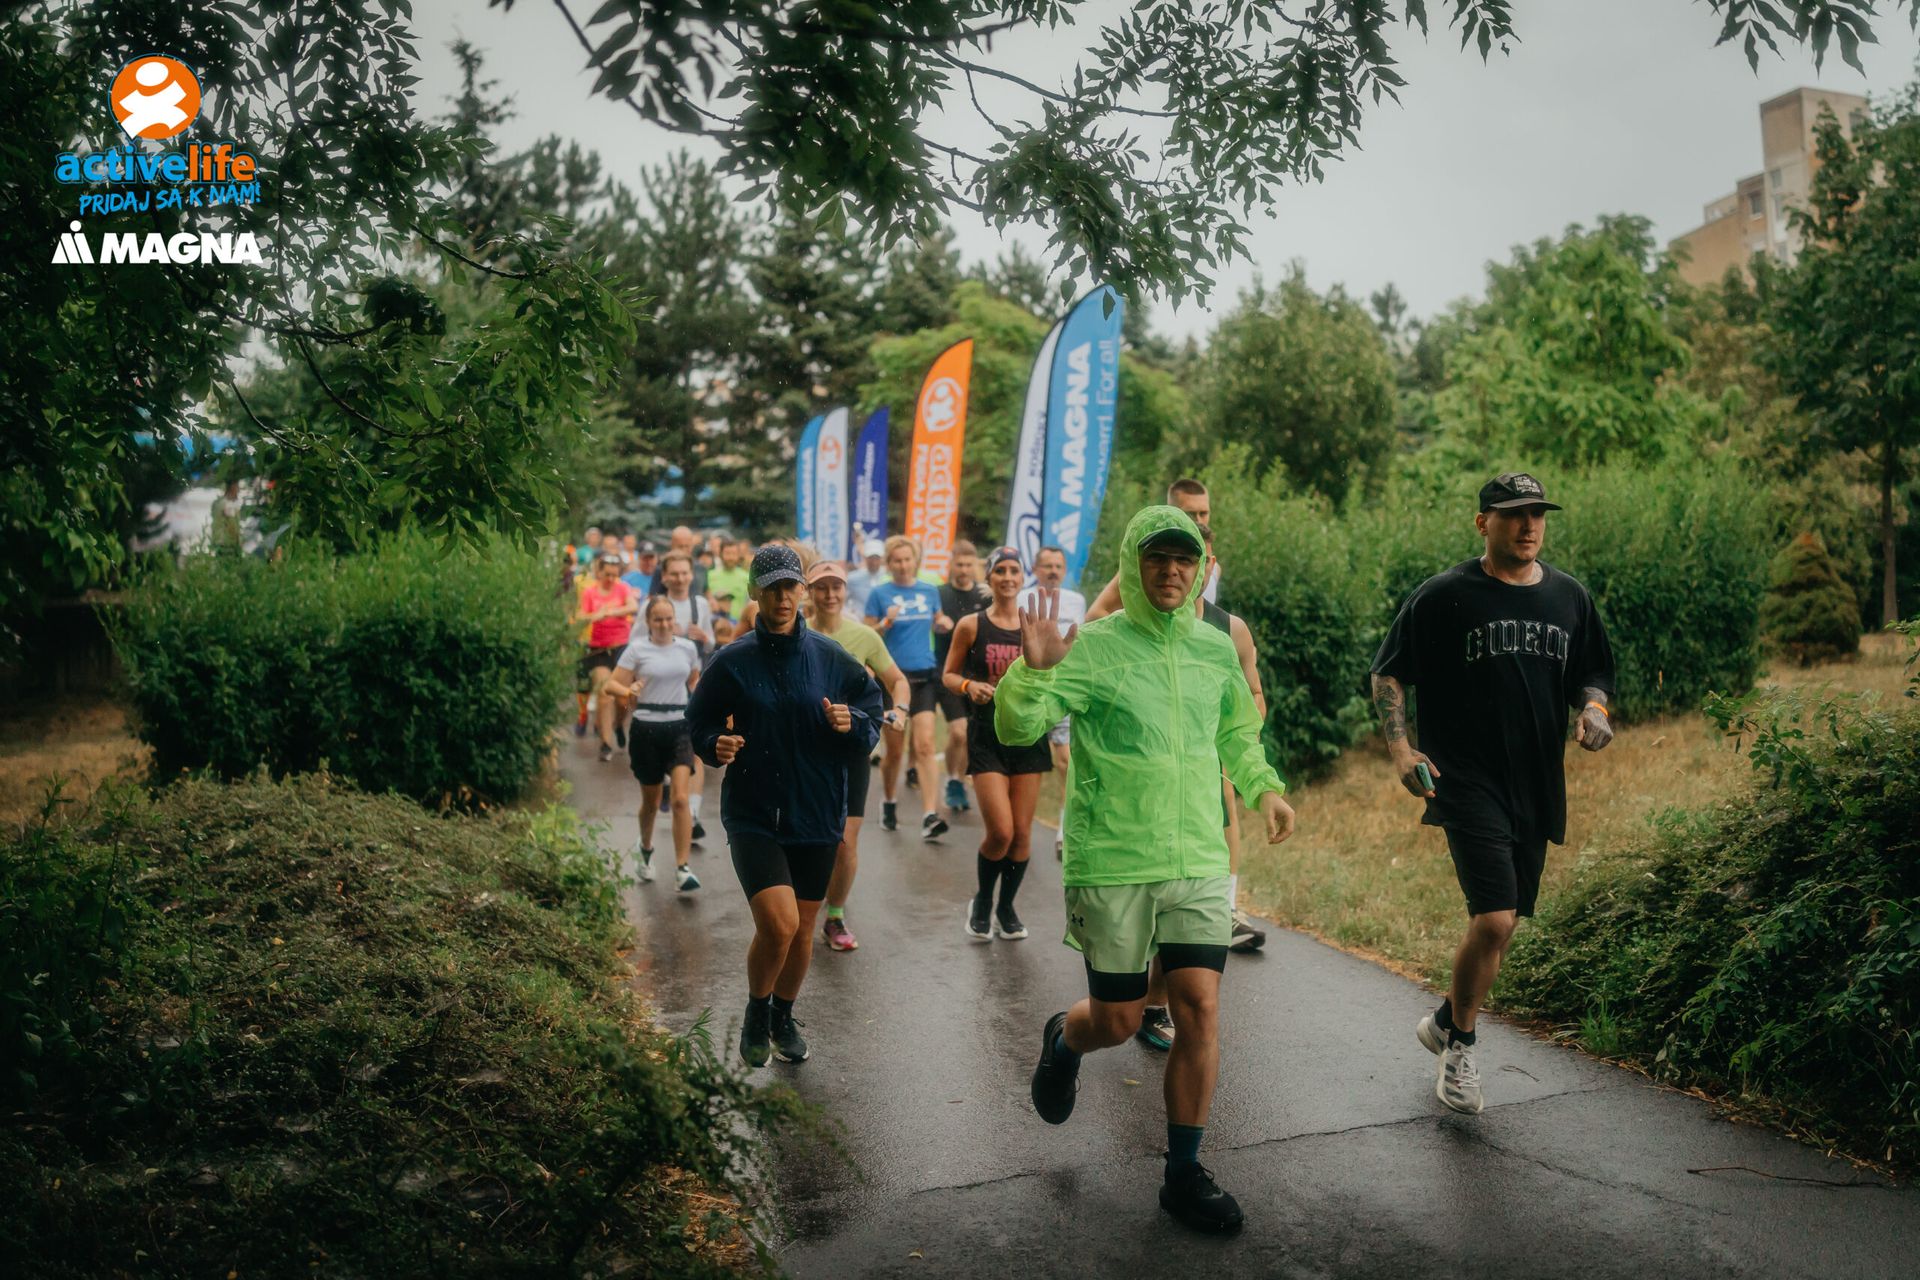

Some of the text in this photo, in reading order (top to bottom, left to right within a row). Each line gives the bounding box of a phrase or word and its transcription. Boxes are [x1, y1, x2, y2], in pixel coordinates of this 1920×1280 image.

[1096, 371, 1116, 405] For
[1098, 340, 1115, 364] all
[1060, 341, 1091, 507] MAGNA
[922, 444, 956, 577] activeli
